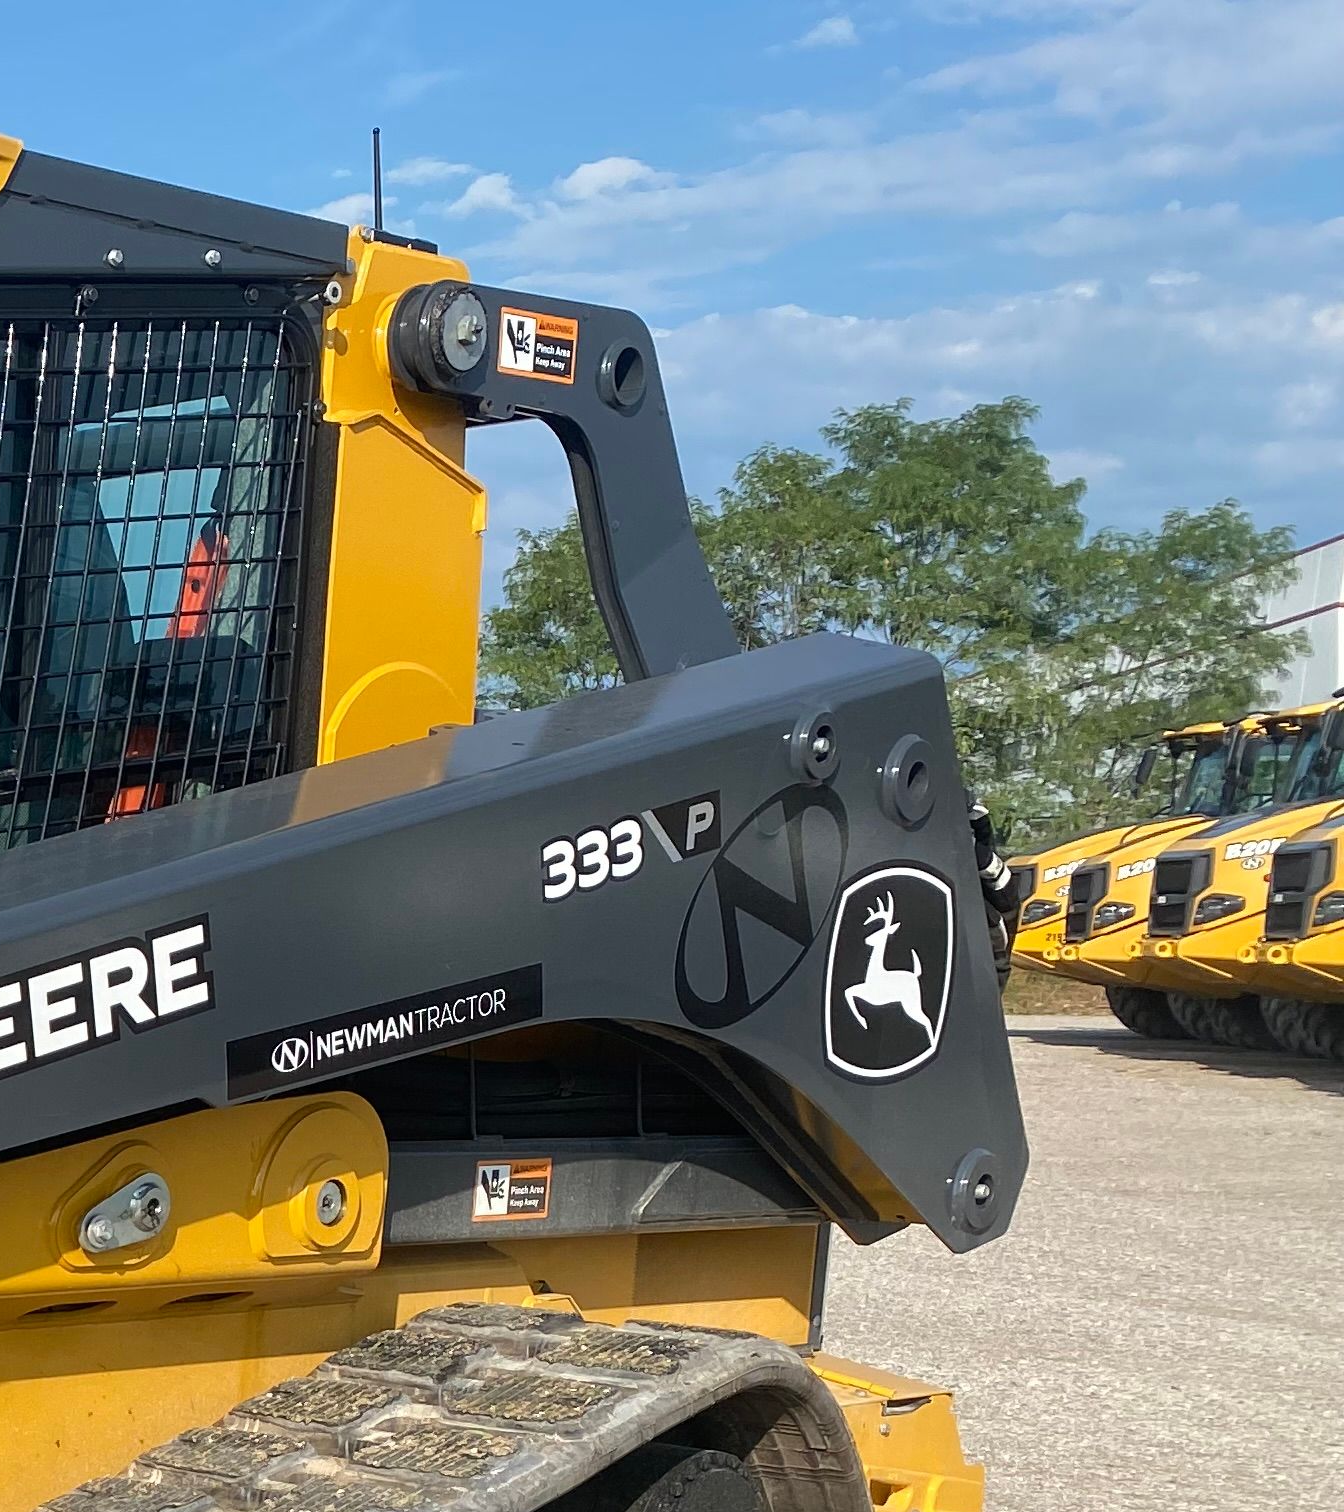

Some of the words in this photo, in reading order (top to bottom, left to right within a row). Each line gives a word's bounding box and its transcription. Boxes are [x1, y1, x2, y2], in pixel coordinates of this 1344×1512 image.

[536, 343, 555, 355] Pinch
[555, 346, 571, 357] Area
[535, 357, 550, 367] Keep
[550, 359, 565, 371] Away
[510, 1185, 529, 1196] Pinch
[529, 1185, 545, 1194] Area
[509, 1199, 523, 1208] Keep
[525, 1198, 540, 1207] Away
